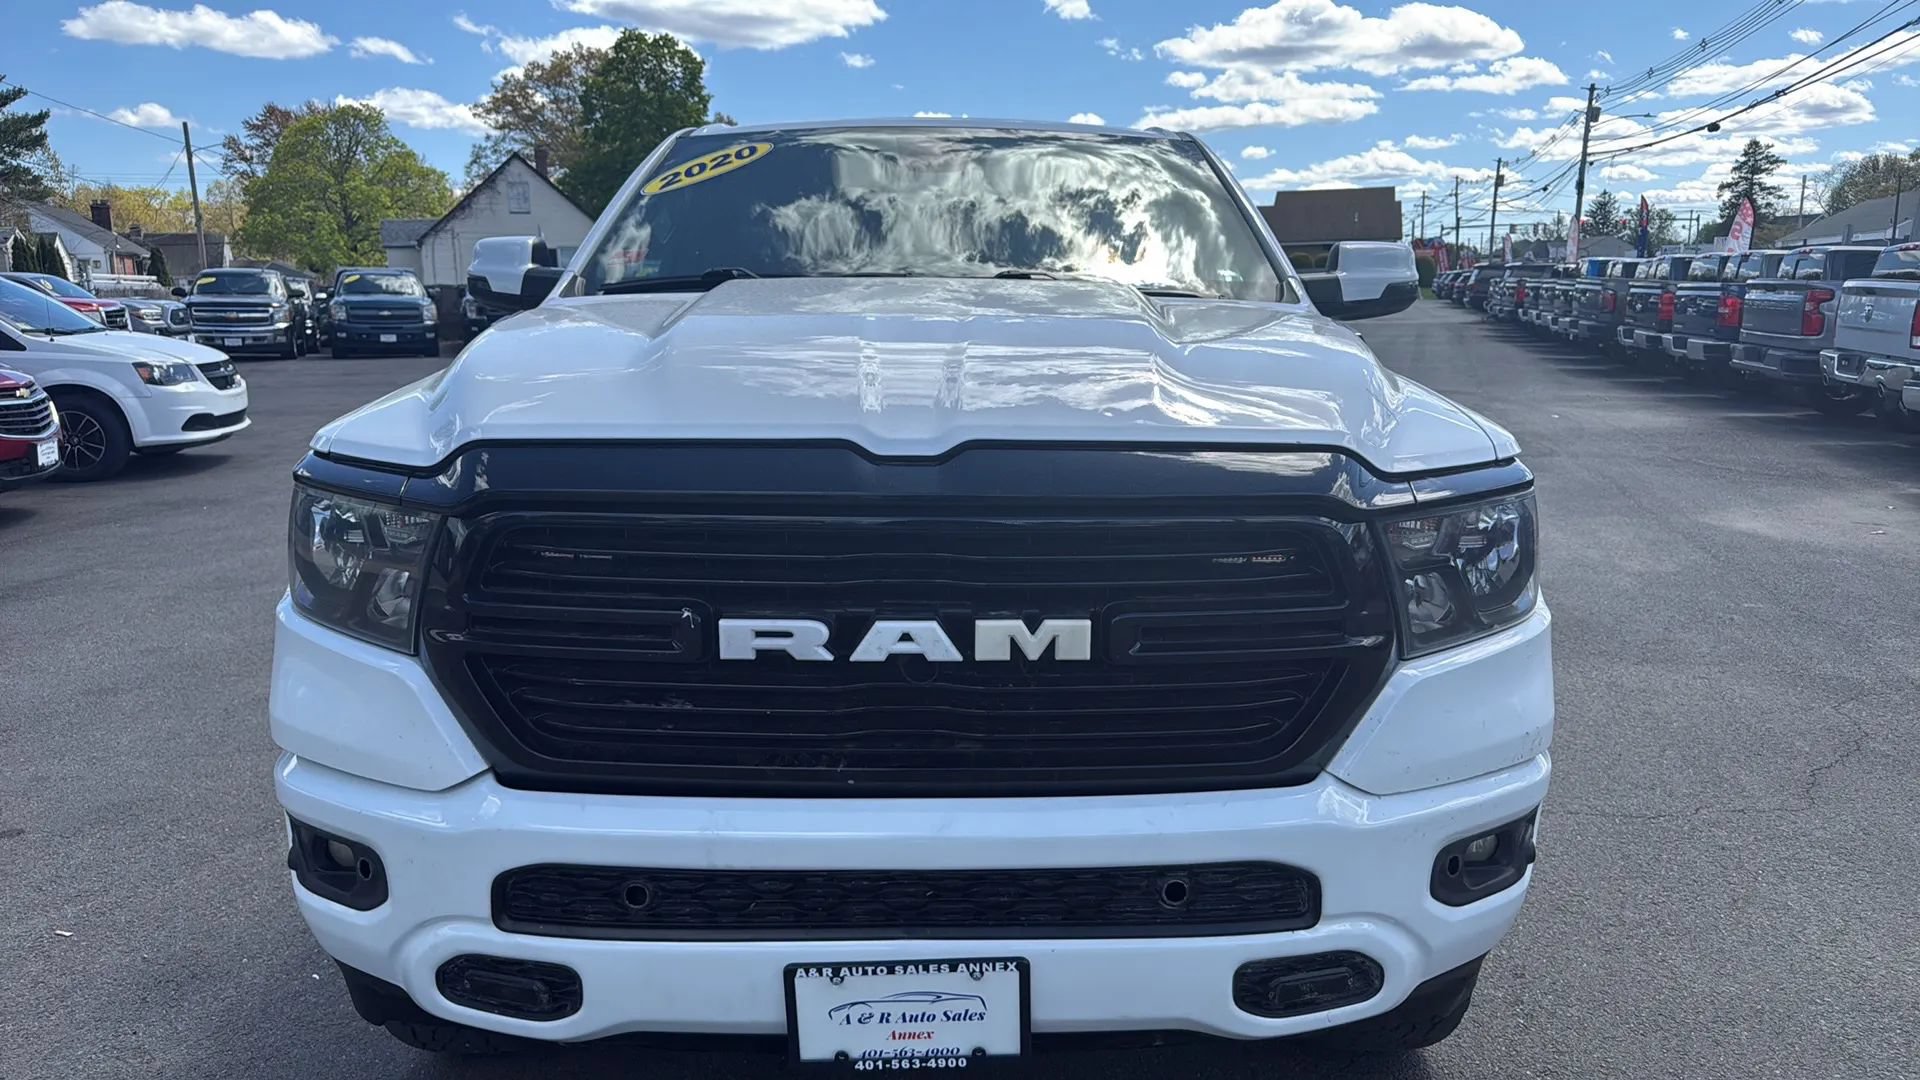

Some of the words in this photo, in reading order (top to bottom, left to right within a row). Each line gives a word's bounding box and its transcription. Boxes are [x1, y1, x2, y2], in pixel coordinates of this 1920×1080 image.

[658, 145, 758, 190] 2020
[718, 618, 1092, 662] RAM
[795, 968, 833, 979] A&R
[840, 966, 888, 977] AUTO
[894, 964, 950, 975] SALES
[956, 962, 1019, 973] ANNEX
[839, 1011, 852, 1026] A
[857, 1012, 875, 1024] &
[878, 1012, 892, 1024] R
[896, 1010, 936, 1024] Auto
[940, 1008, 986, 1022] Sales
[886, 1030, 935, 1041] Annex
[854, 1057, 967, 1071] 401-563-4900
